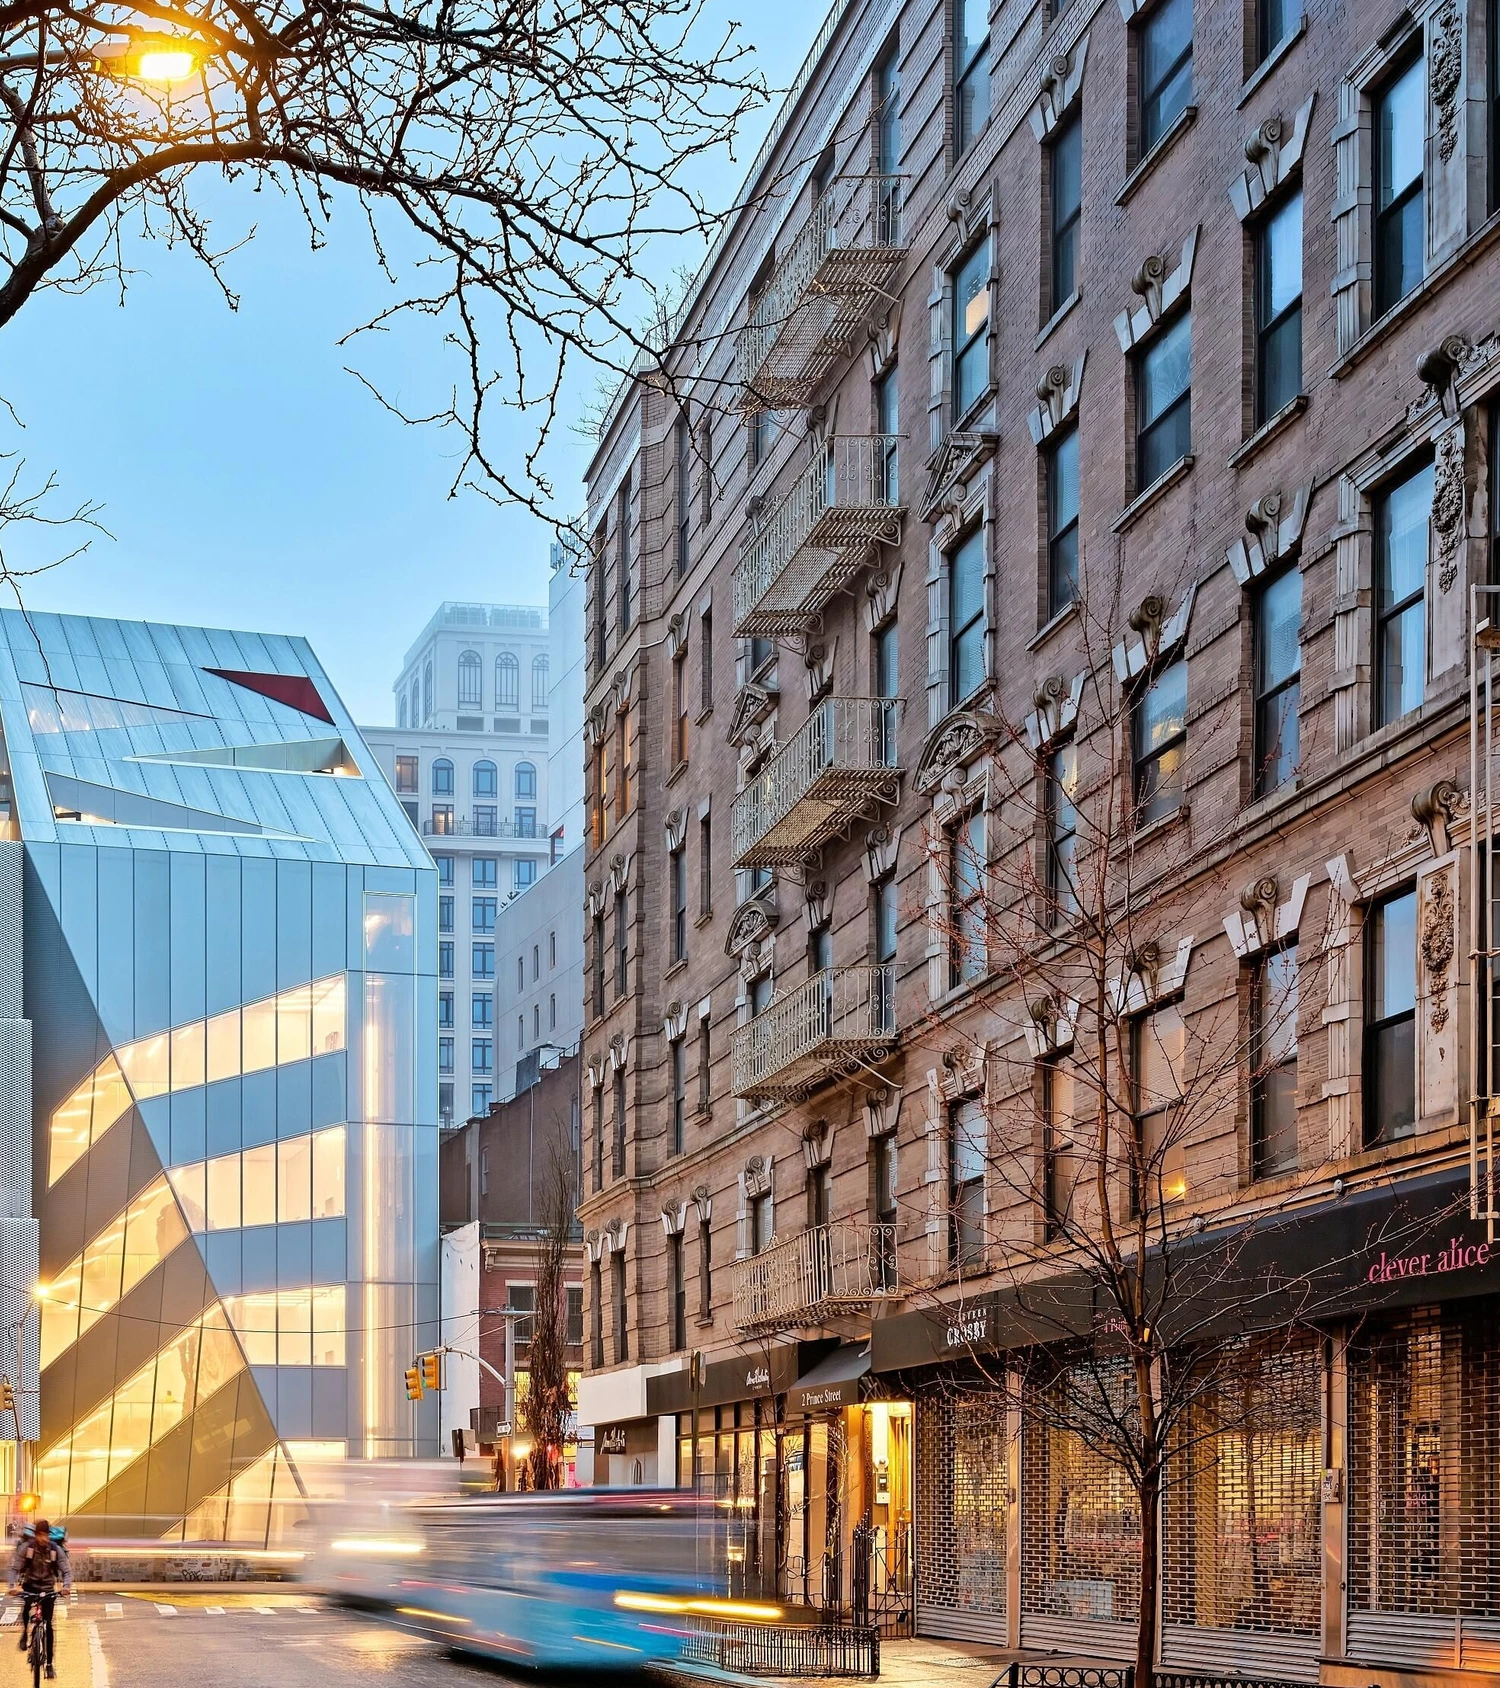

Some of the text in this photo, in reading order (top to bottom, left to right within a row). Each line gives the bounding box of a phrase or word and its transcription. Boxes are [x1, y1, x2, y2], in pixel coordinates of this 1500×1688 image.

[1368, 1236, 1490, 1284] clever alice
[946, 1320, 987, 1347] CROSBY
[801, 1393, 806, 1407] 2
[806, 1391, 824, 1406] Prince
[824, 1388, 842, 1403] Street
